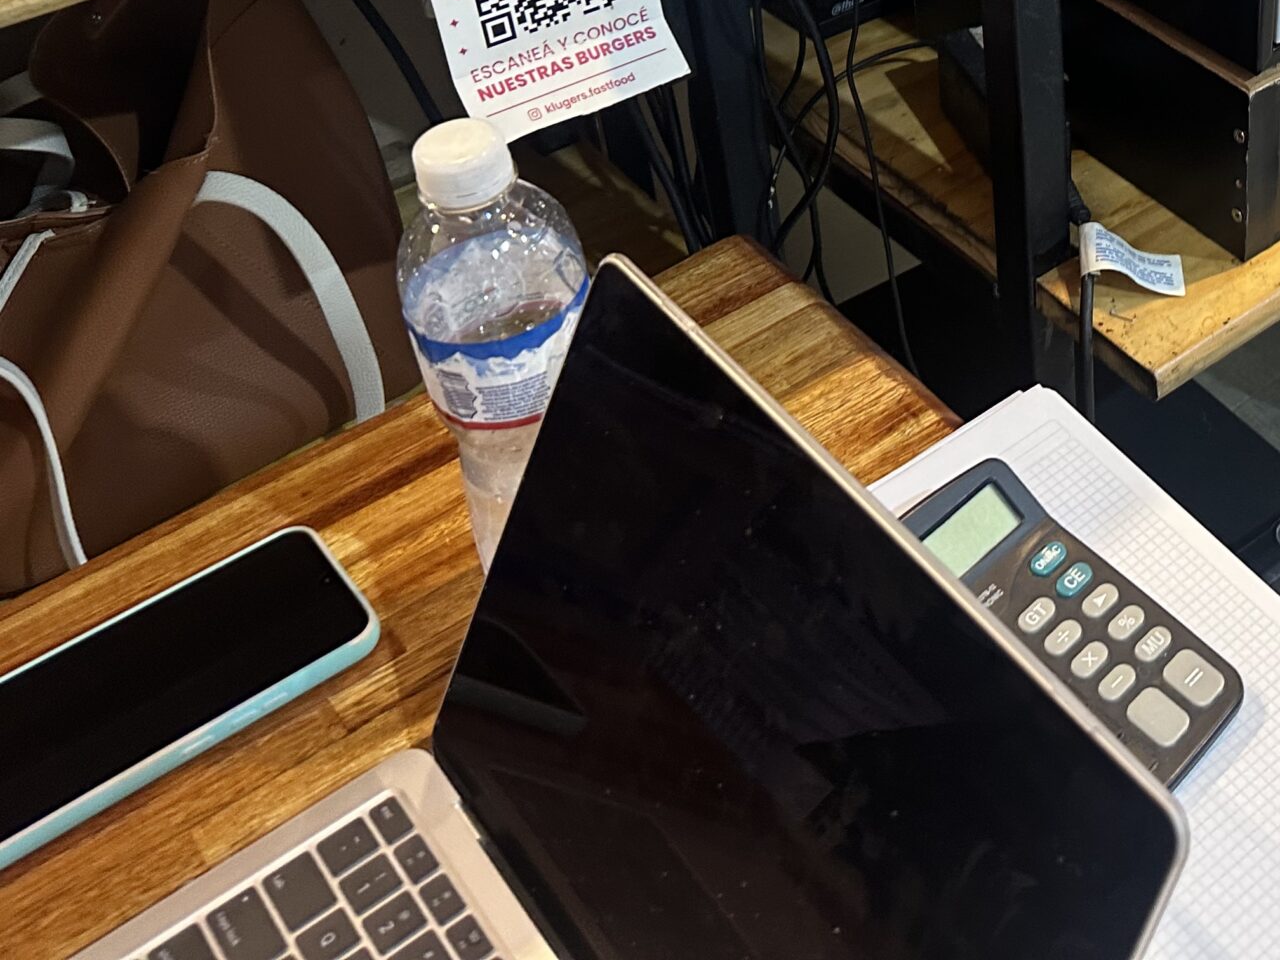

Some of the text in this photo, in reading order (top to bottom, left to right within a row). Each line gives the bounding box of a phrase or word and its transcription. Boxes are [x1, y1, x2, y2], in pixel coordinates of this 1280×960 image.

[470, 6, 650, 84] ESCANEÁ Y CONOCÉ
[476, 26, 657, 103] NUESTRAS BURGERS
[544, 72, 637, 115] klugers.fastfood
[1063, 568, 1086, 590] CE
[1024, 603, 1047, 625] GT
[1140, 631, 1166, 656] MU
[378, 920, 396, 935] 2
[319, 932, 337, 949] Q
